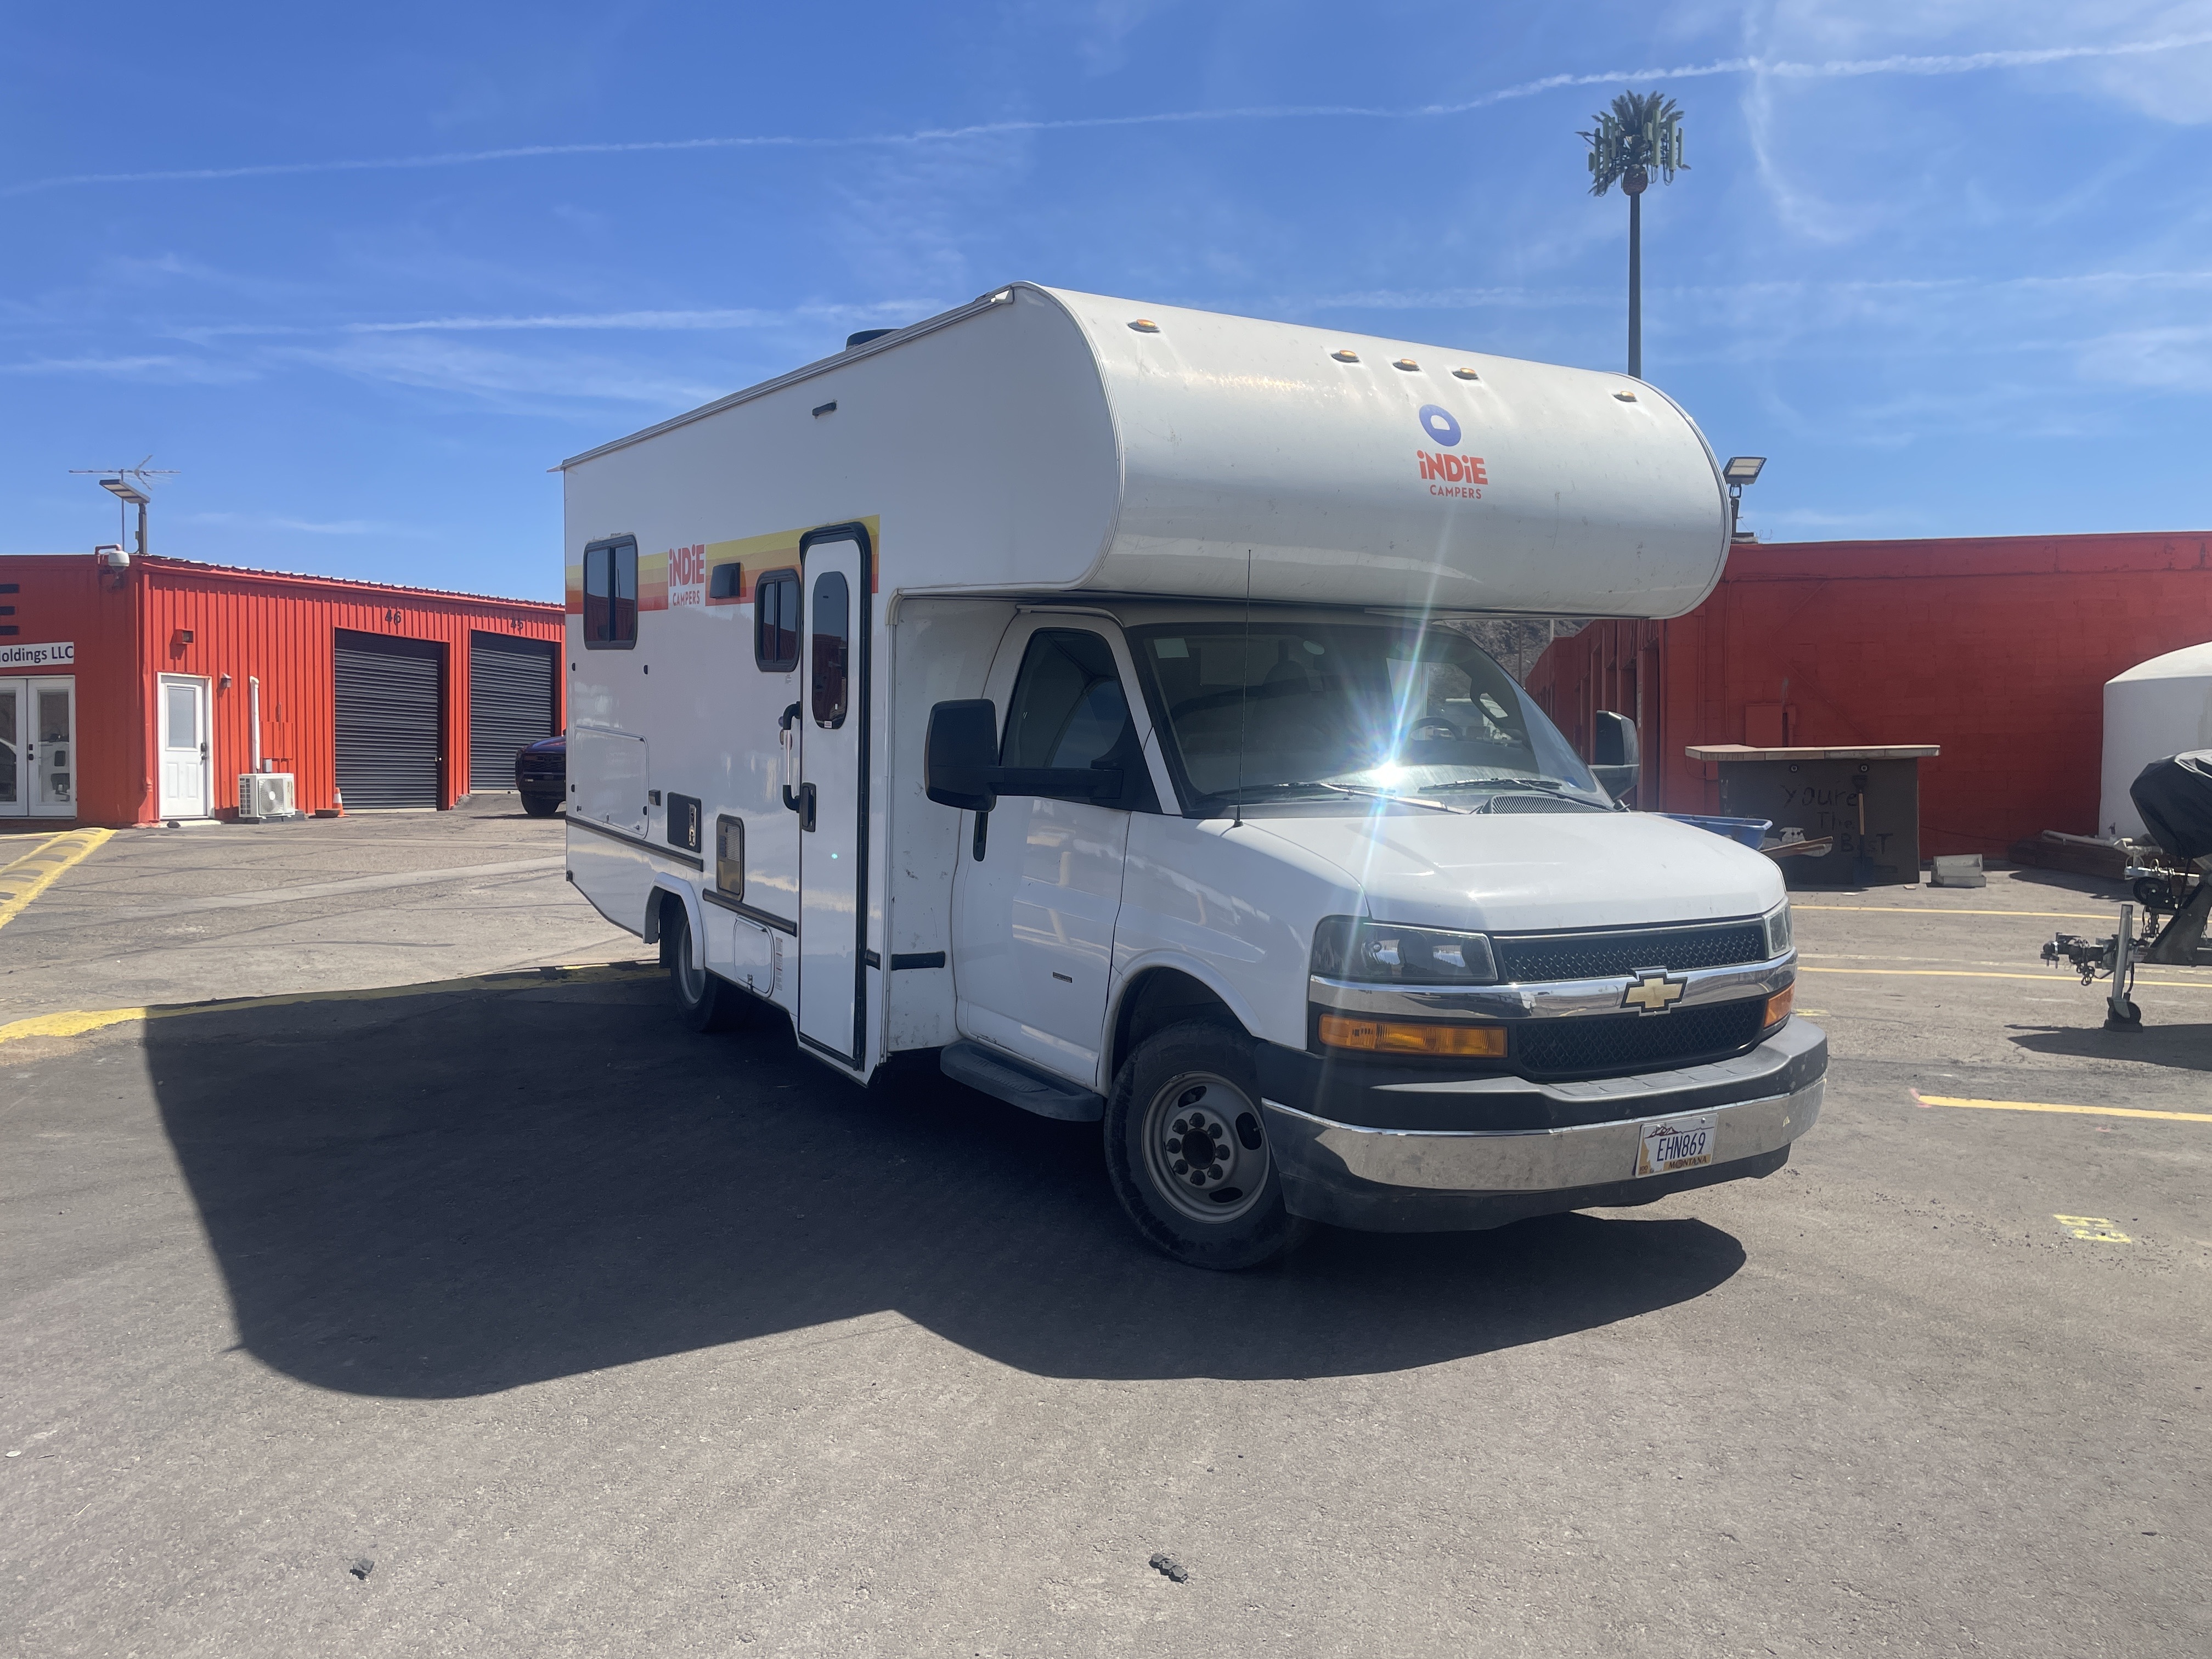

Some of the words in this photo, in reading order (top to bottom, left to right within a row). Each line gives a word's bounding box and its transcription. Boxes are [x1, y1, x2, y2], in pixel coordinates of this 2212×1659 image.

[1430, 484, 1482, 499] CAMPERS
[673, 590, 700, 606] CAMPERS
[385, 609, 402, 626] 46
[0, 647, 48, 664] oldings
[52, 645, 74, 659] LLC
[1656, 1132, 1706, 1162] EHN869
[1668, 1155, 1707, 1170] MONTANA
